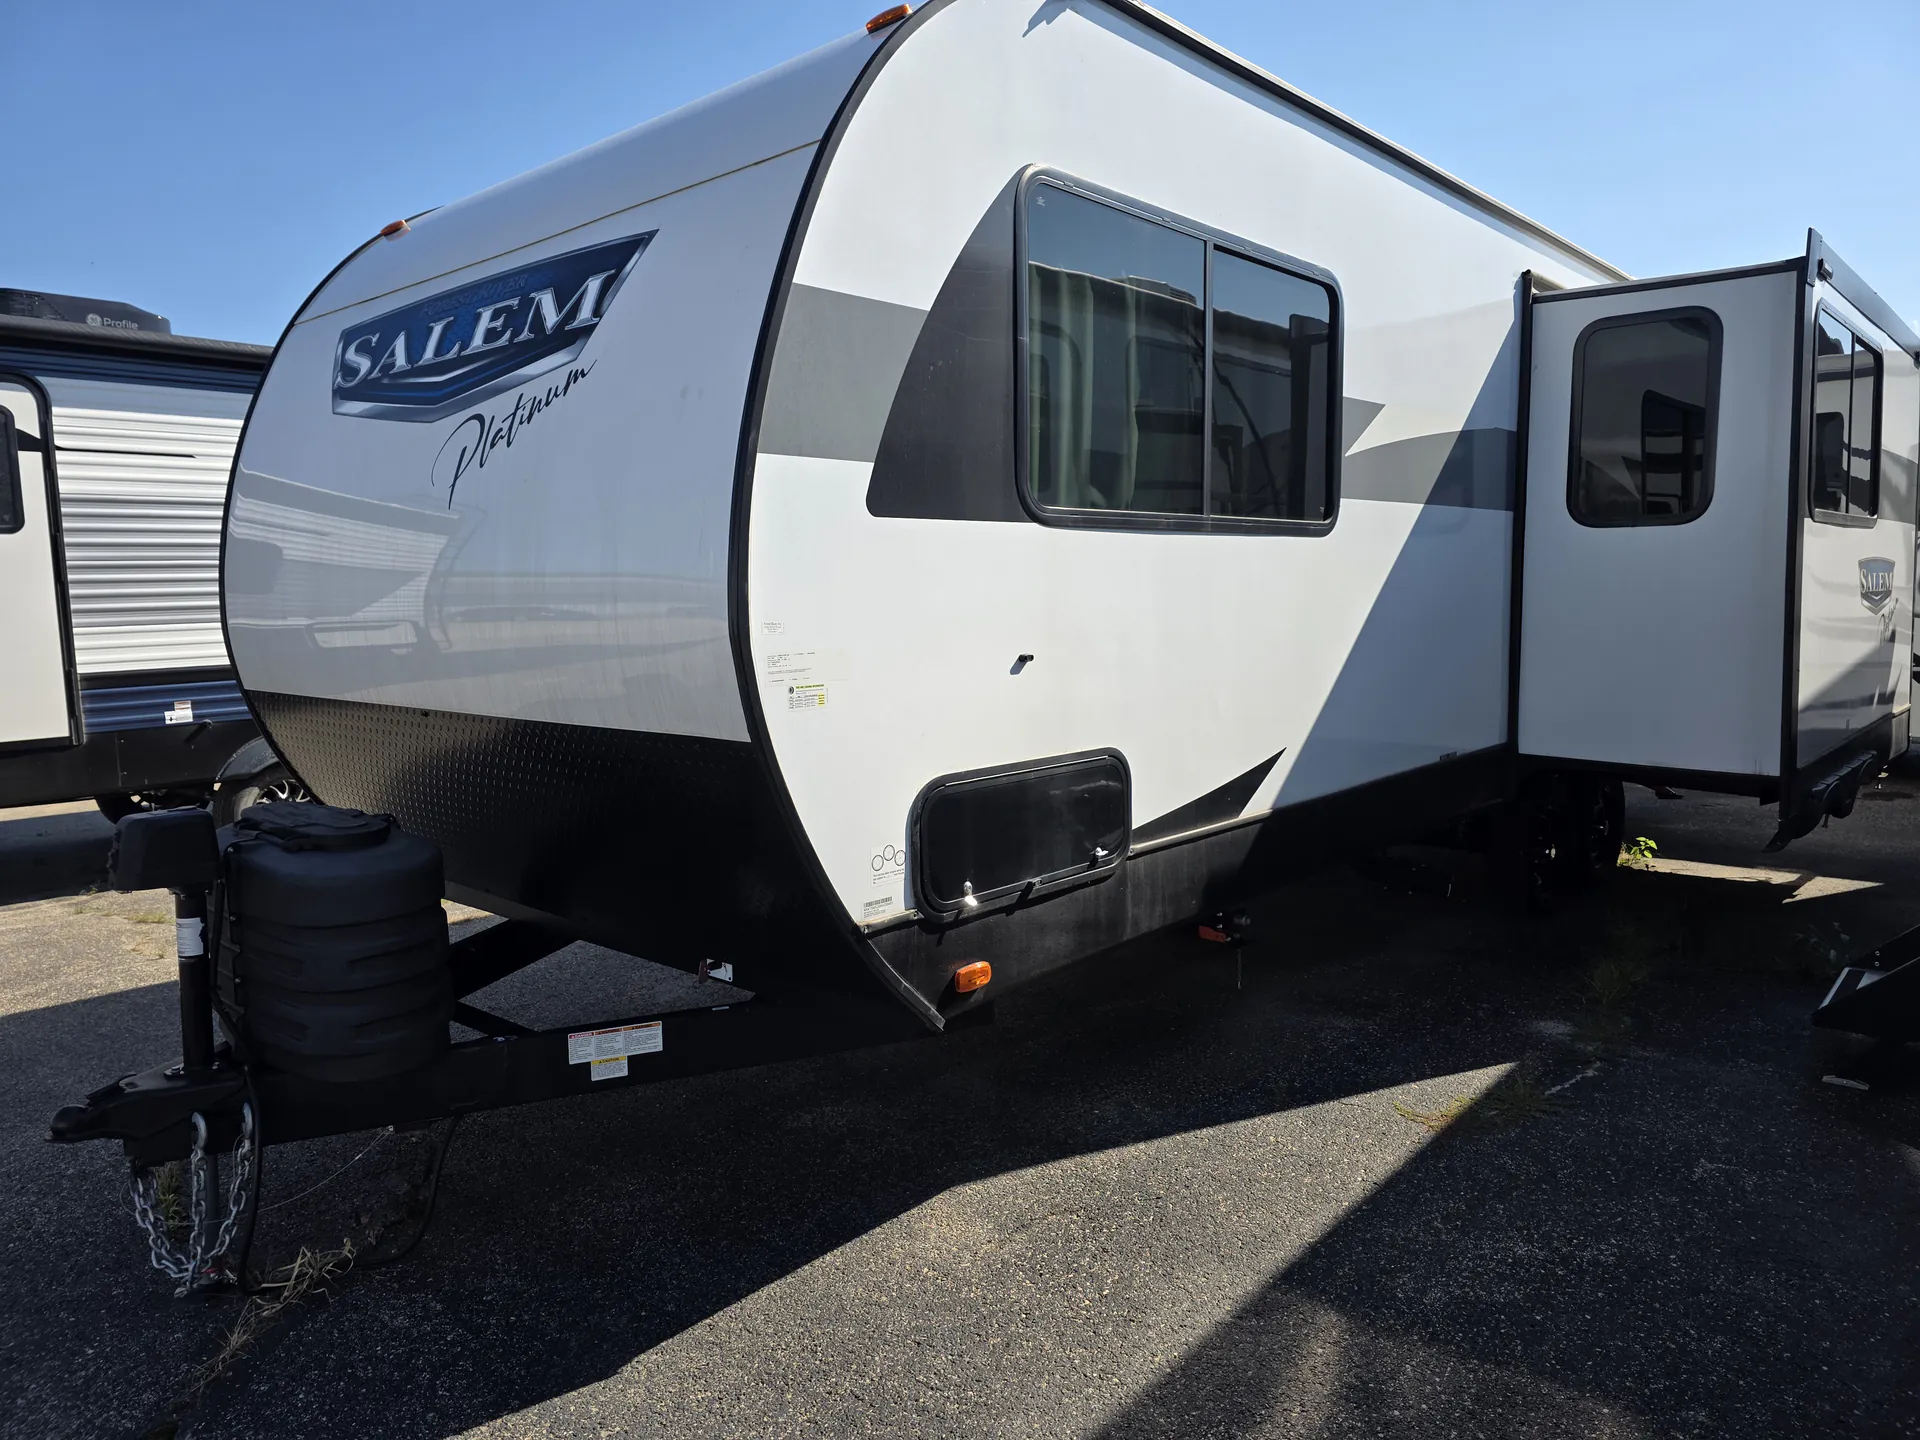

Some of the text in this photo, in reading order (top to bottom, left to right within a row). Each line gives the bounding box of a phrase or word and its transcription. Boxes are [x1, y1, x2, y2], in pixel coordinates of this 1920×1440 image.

[103, 317, 138, 330] Profile
[333, 269, 617, 388] SALEM
[431, 359, 598, 510] Platinum
[1860, 568, 1893, 593] SALEM
